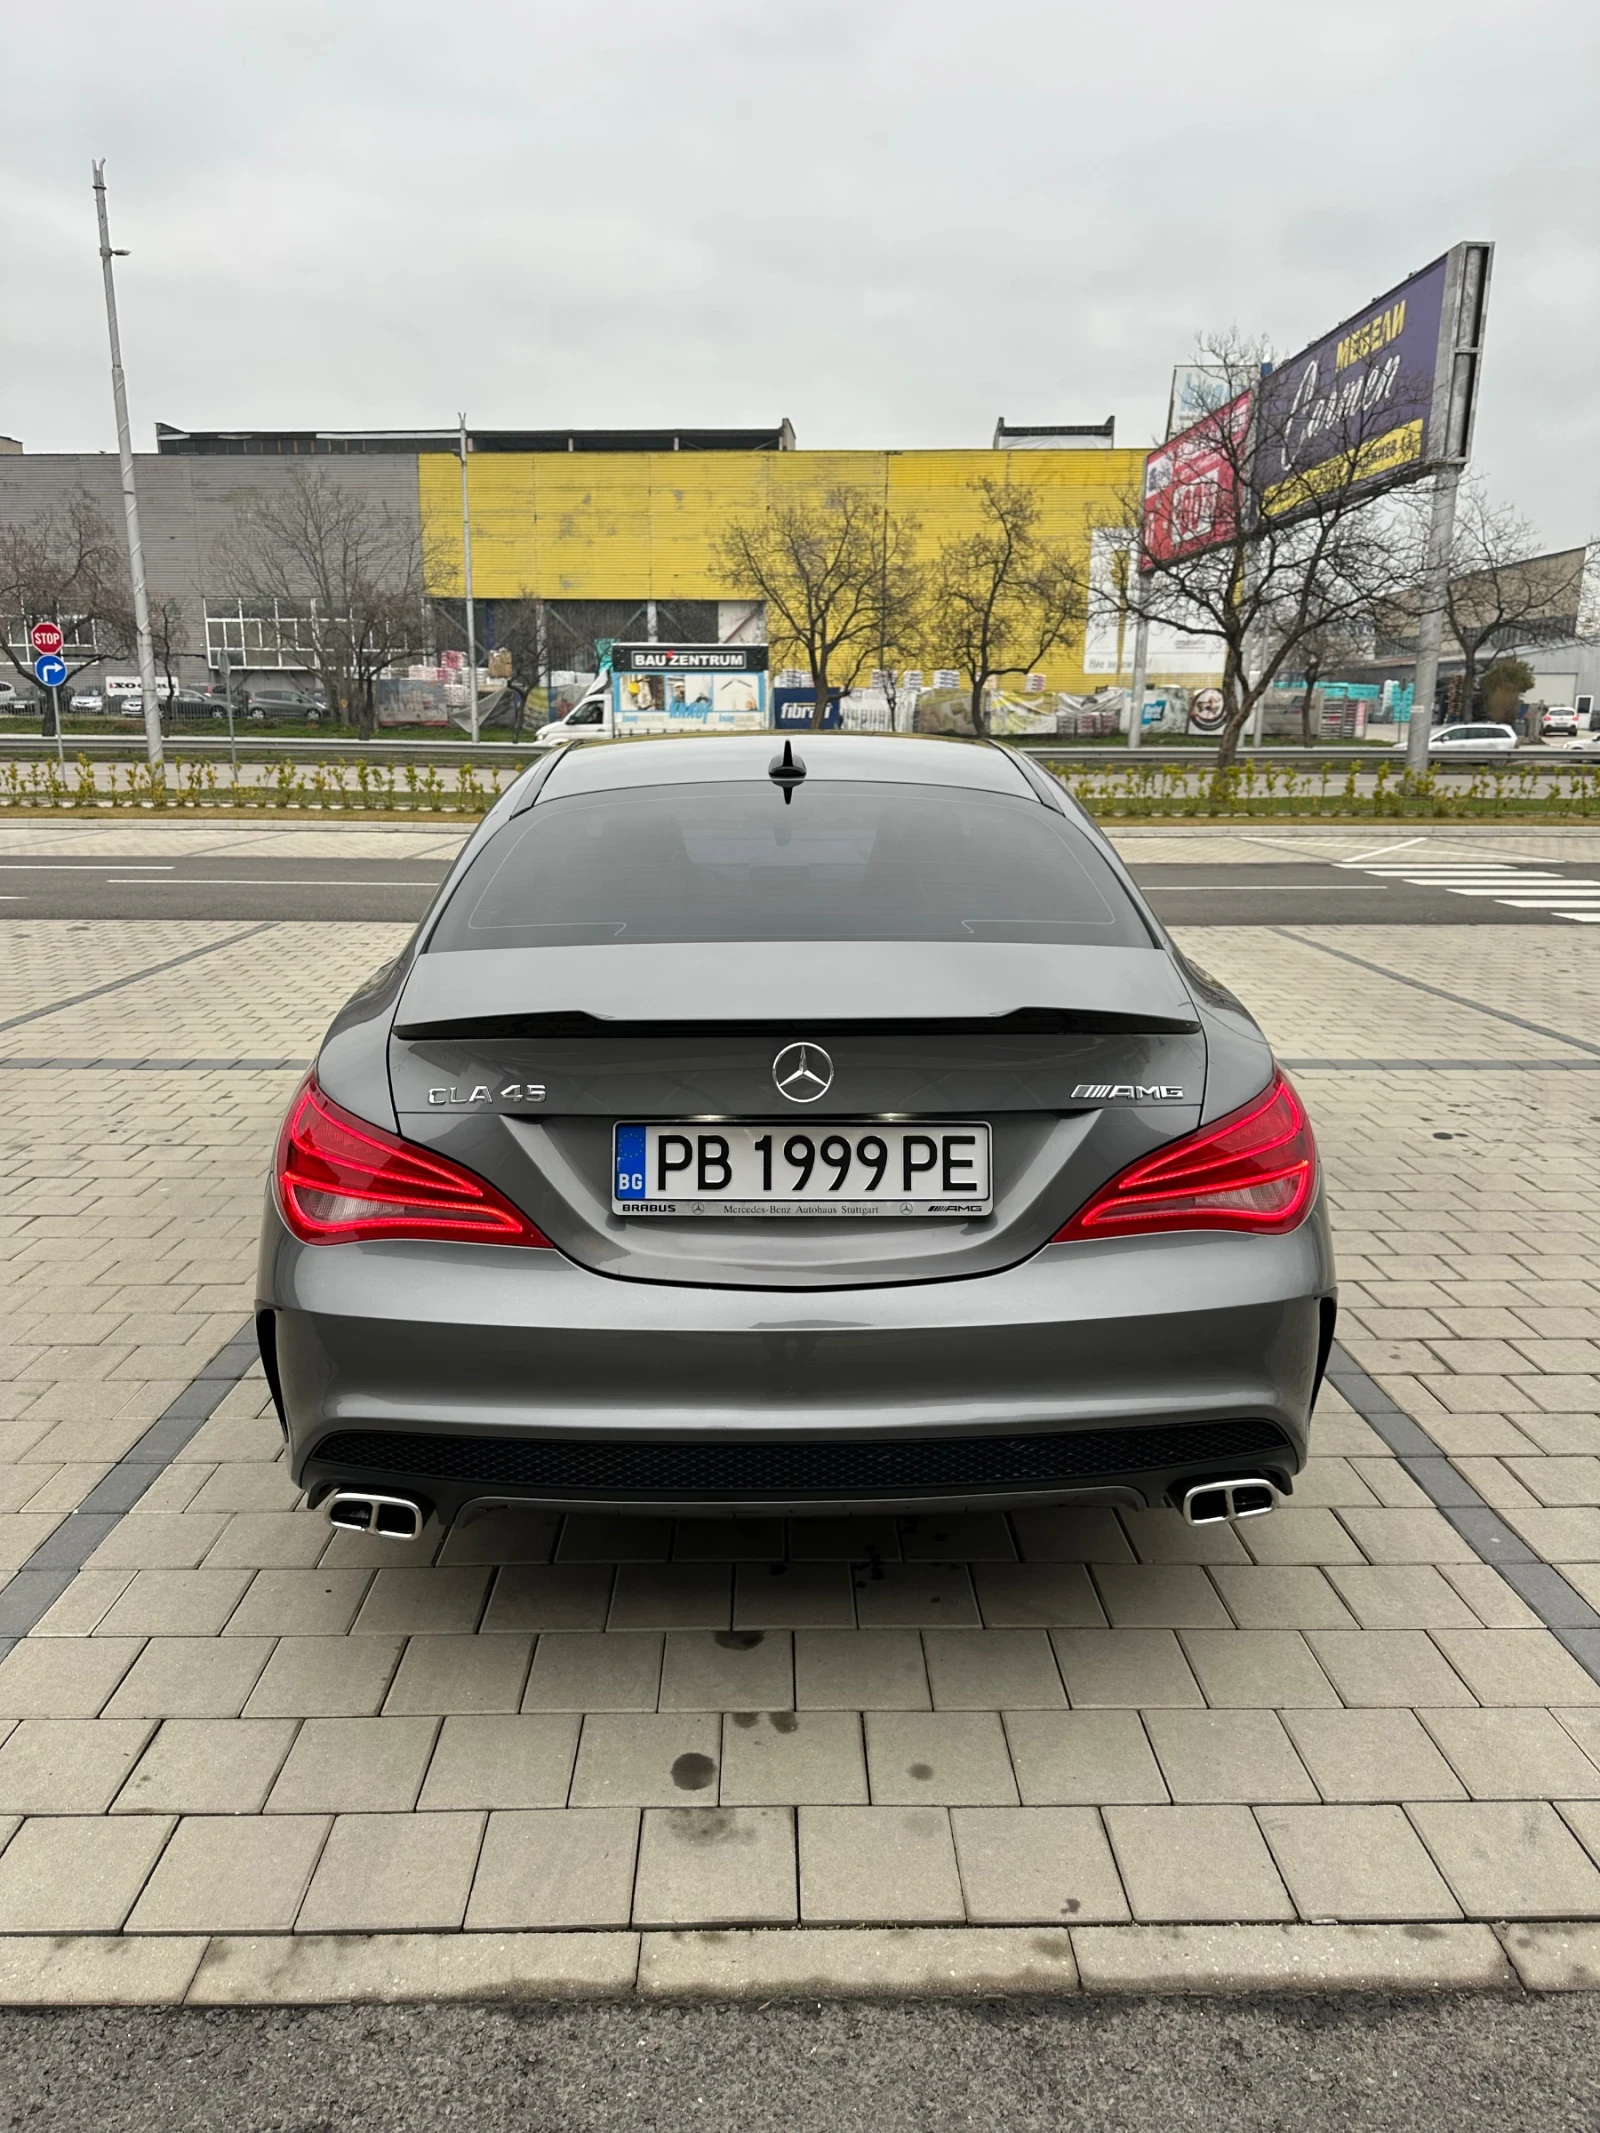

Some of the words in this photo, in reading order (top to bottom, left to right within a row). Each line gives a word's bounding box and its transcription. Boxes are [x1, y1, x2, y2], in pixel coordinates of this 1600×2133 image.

[1336, 300, 1406, 372] МЕБЕЛИ
[34, 632, 60, 645] STOP
[428, 1085, 493, 1104] CLA
[500, 1084, 546, 1102] 45
[1108, 1085, 1184, 1099] AMG
[658, 1135, 732, 1191] PB
[754, 1135, 888, 1191] 1999
[903, 1135, 978, 1191] PE
[619, 1173, 643, 1190] BG
[622, 1204, 676, 1212] BRABUS
[723, 1205, 791, 1214] Mercedes-Benz
[795, 1205, 837, 1214] Autohaus
[841, 1205, 879, 1215] Stuttgart
